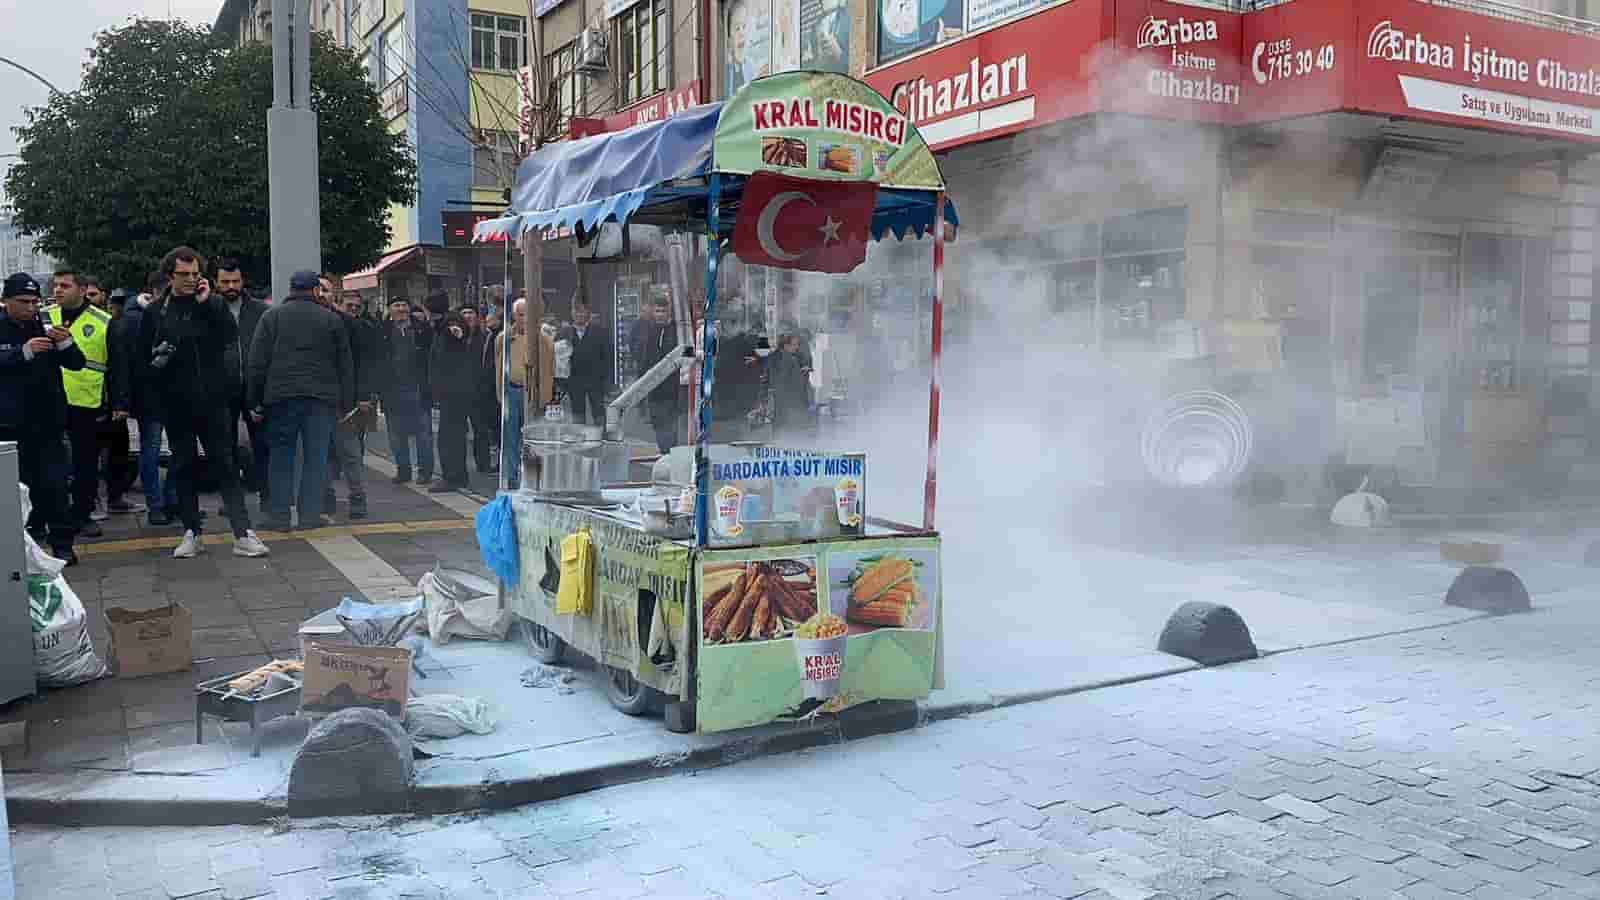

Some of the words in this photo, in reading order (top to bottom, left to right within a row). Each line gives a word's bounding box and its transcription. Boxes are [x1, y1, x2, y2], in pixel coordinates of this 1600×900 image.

[1150, 17, 1218, 47] Erbaa
[1267, 55, 1293, 81] 715
[1295, 49, 1313, 75] 30
[1316, 44, 1335, 71] 40
[1390, 30, 1454, 69] Erbaa
[1463, 32, 1529, 82] İşitme
[1148, 69, 1240, 105] Cihazları
[753, 100, 818, 130] KRAL
[1461, 94, 1488, 117] Satış
[1490, 103, 1501, 114] ve
[1503, 101, 1552, 124] Uygulama
[714, 459, 789, 481] BARDAKTA
[824, 457, 864, 476] MISIR
[805, 654, 841, 669] KRAL
